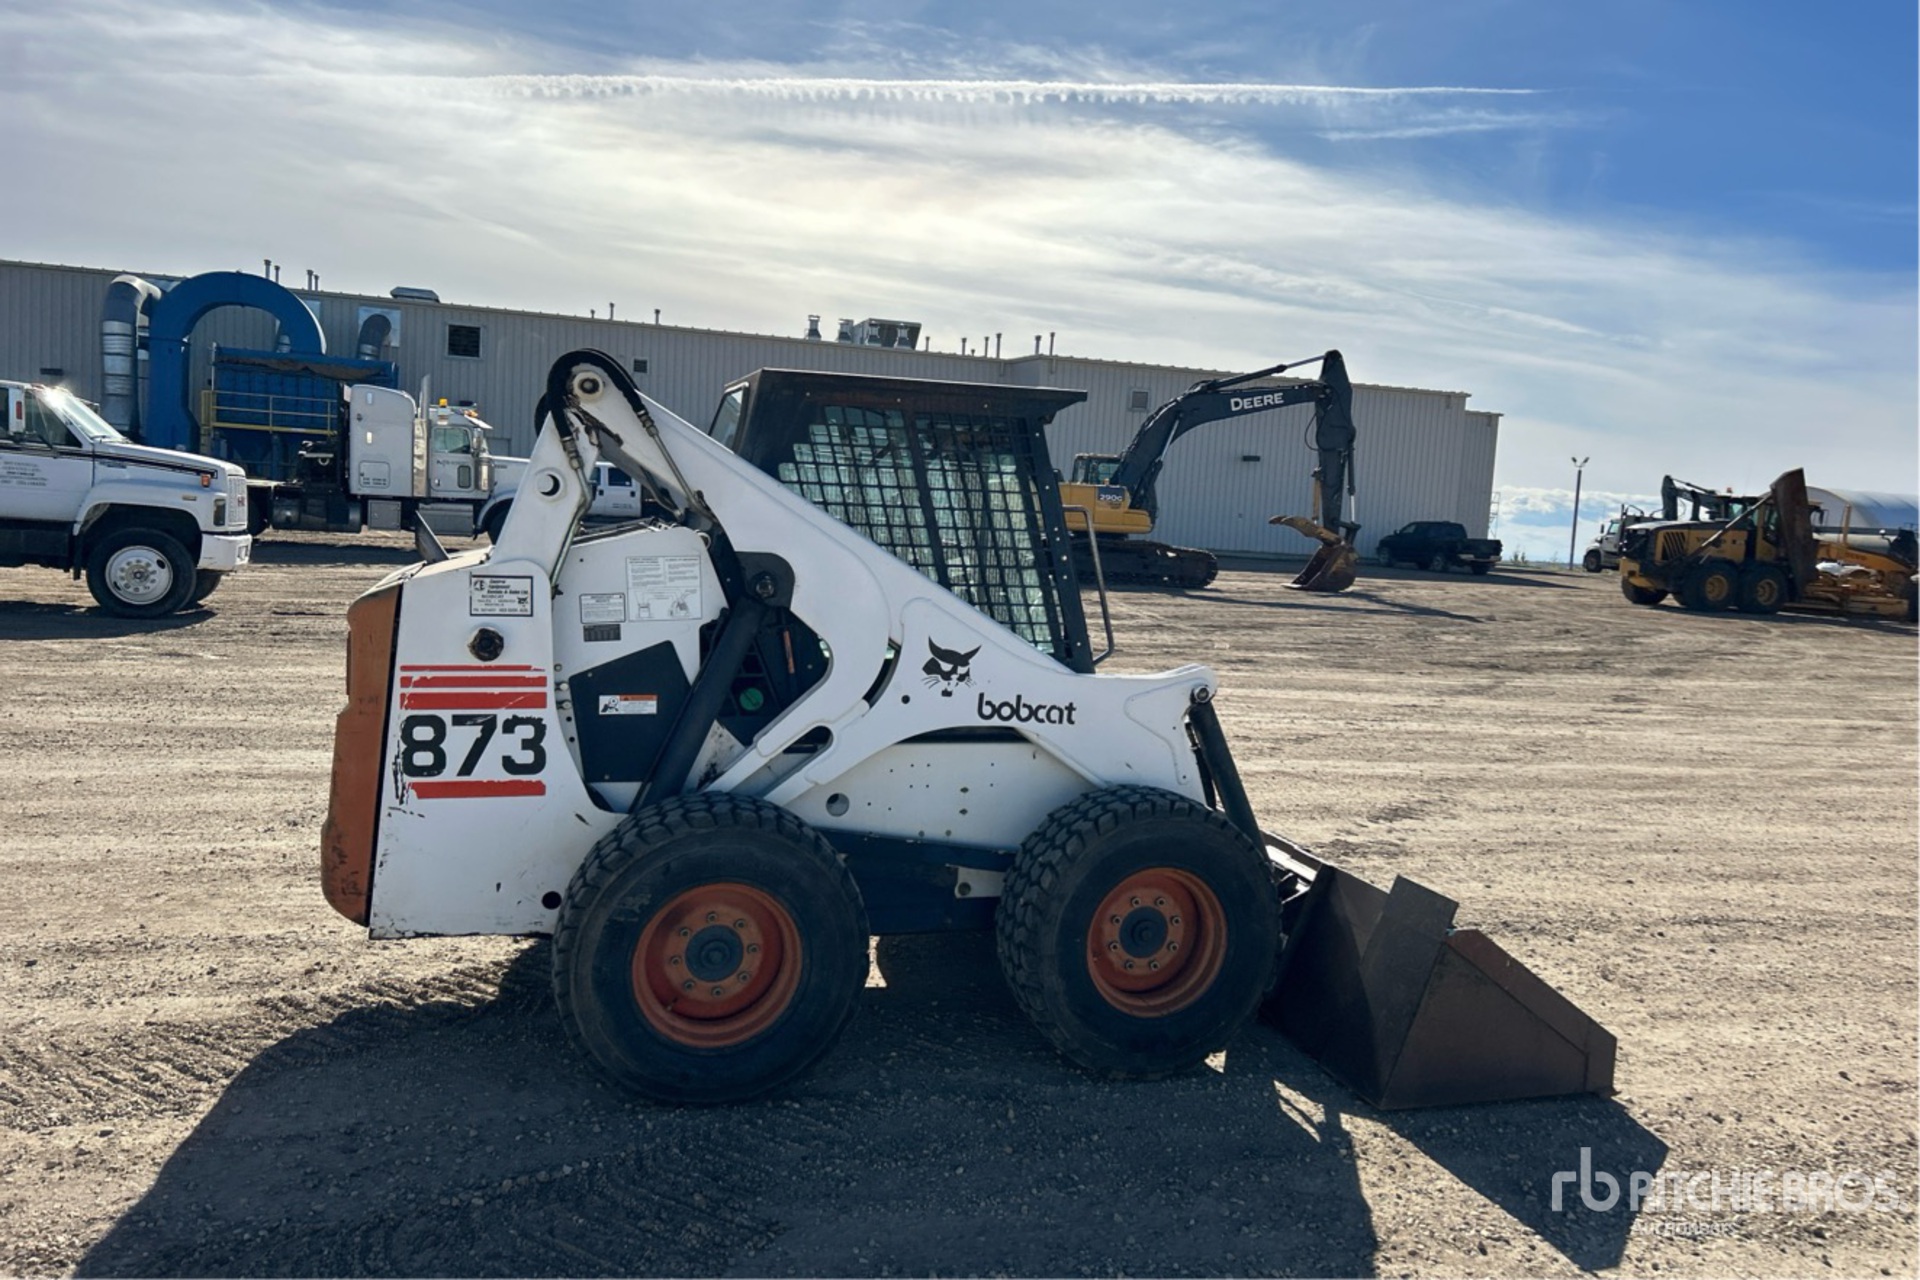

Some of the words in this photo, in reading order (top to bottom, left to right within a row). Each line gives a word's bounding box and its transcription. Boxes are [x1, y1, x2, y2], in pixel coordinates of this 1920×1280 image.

[1230, 392, 1285, 411] DEERE
[977, 692, 1077, 725] bobcat
[401, 714, 546, 777] 873
